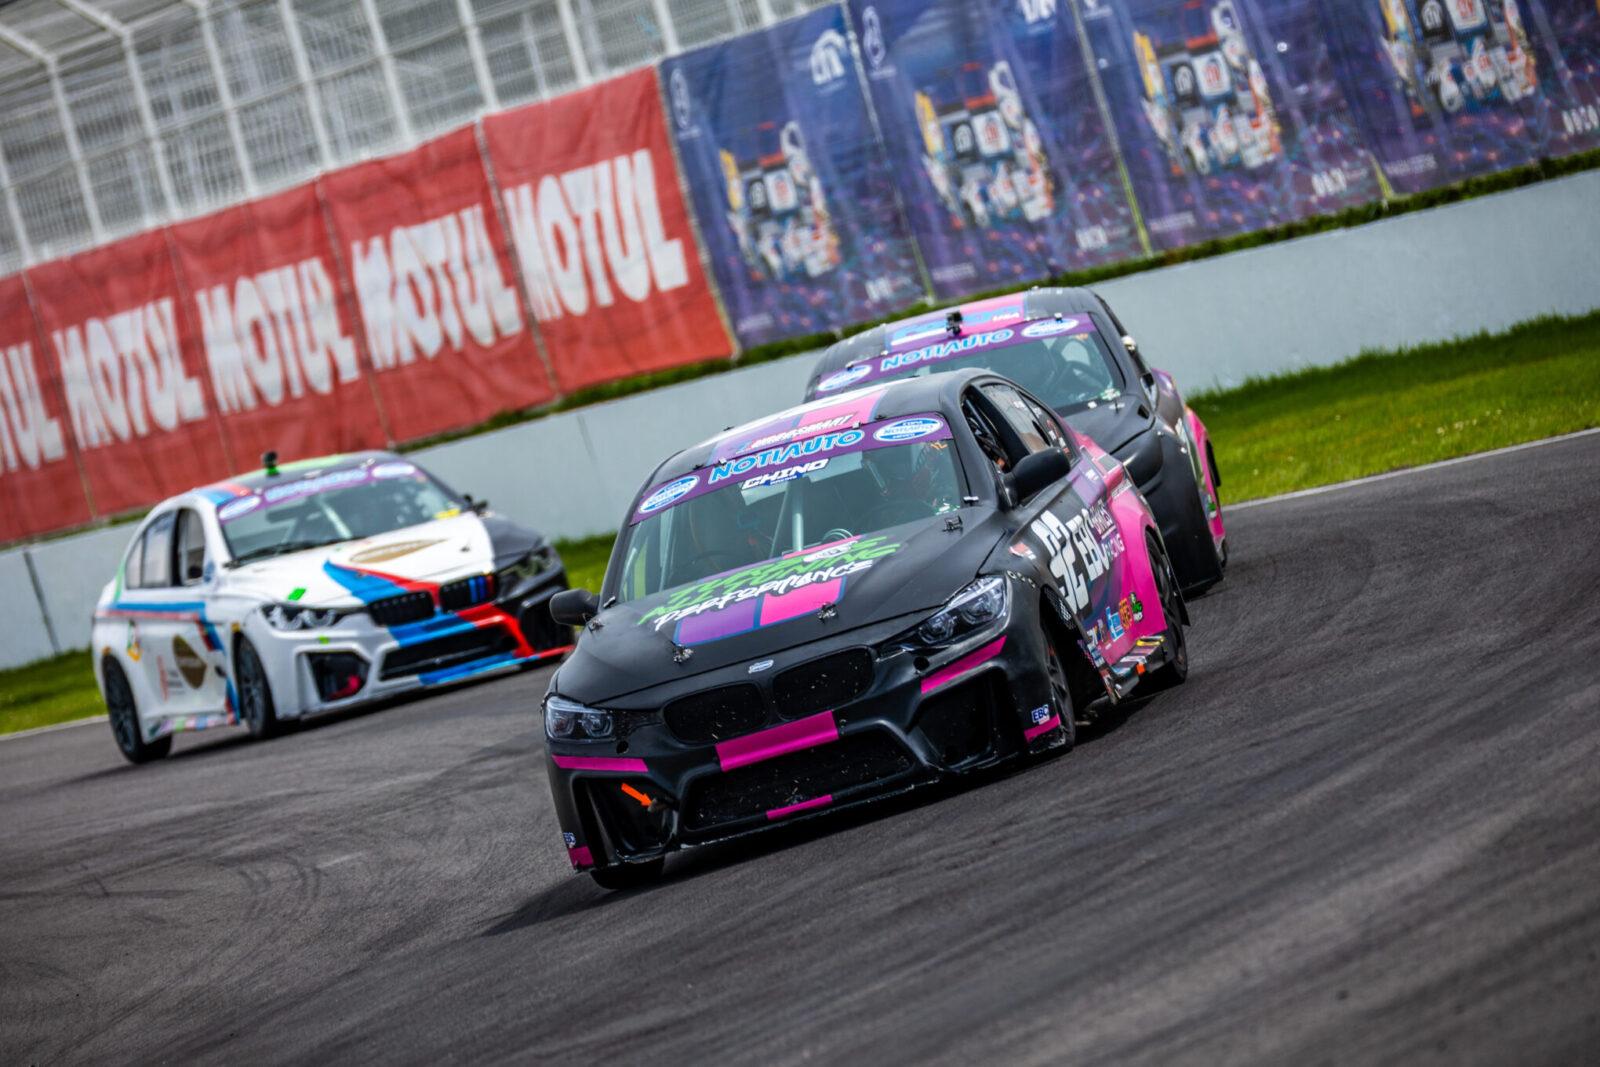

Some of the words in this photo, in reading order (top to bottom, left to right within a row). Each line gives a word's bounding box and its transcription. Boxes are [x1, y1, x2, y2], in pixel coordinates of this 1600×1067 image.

[502, 147, 689, 323] MOTUL
[352, 203, 524, 372] MOTUL
[195, 256, 360, 414] MOTUL
[880, 329, 1015, 372] NOTIAUTO
[52, 296, 208, 452] MOTUL
[707, 429, 865, 485] NOTIAUTO
[741, 458, 829, 490] CHINO
[1065, 508, 1109, 581] EBC
[653, 559, 874, 632] PERFORMANCE
[1032, 705, 1049, 721] EBC
